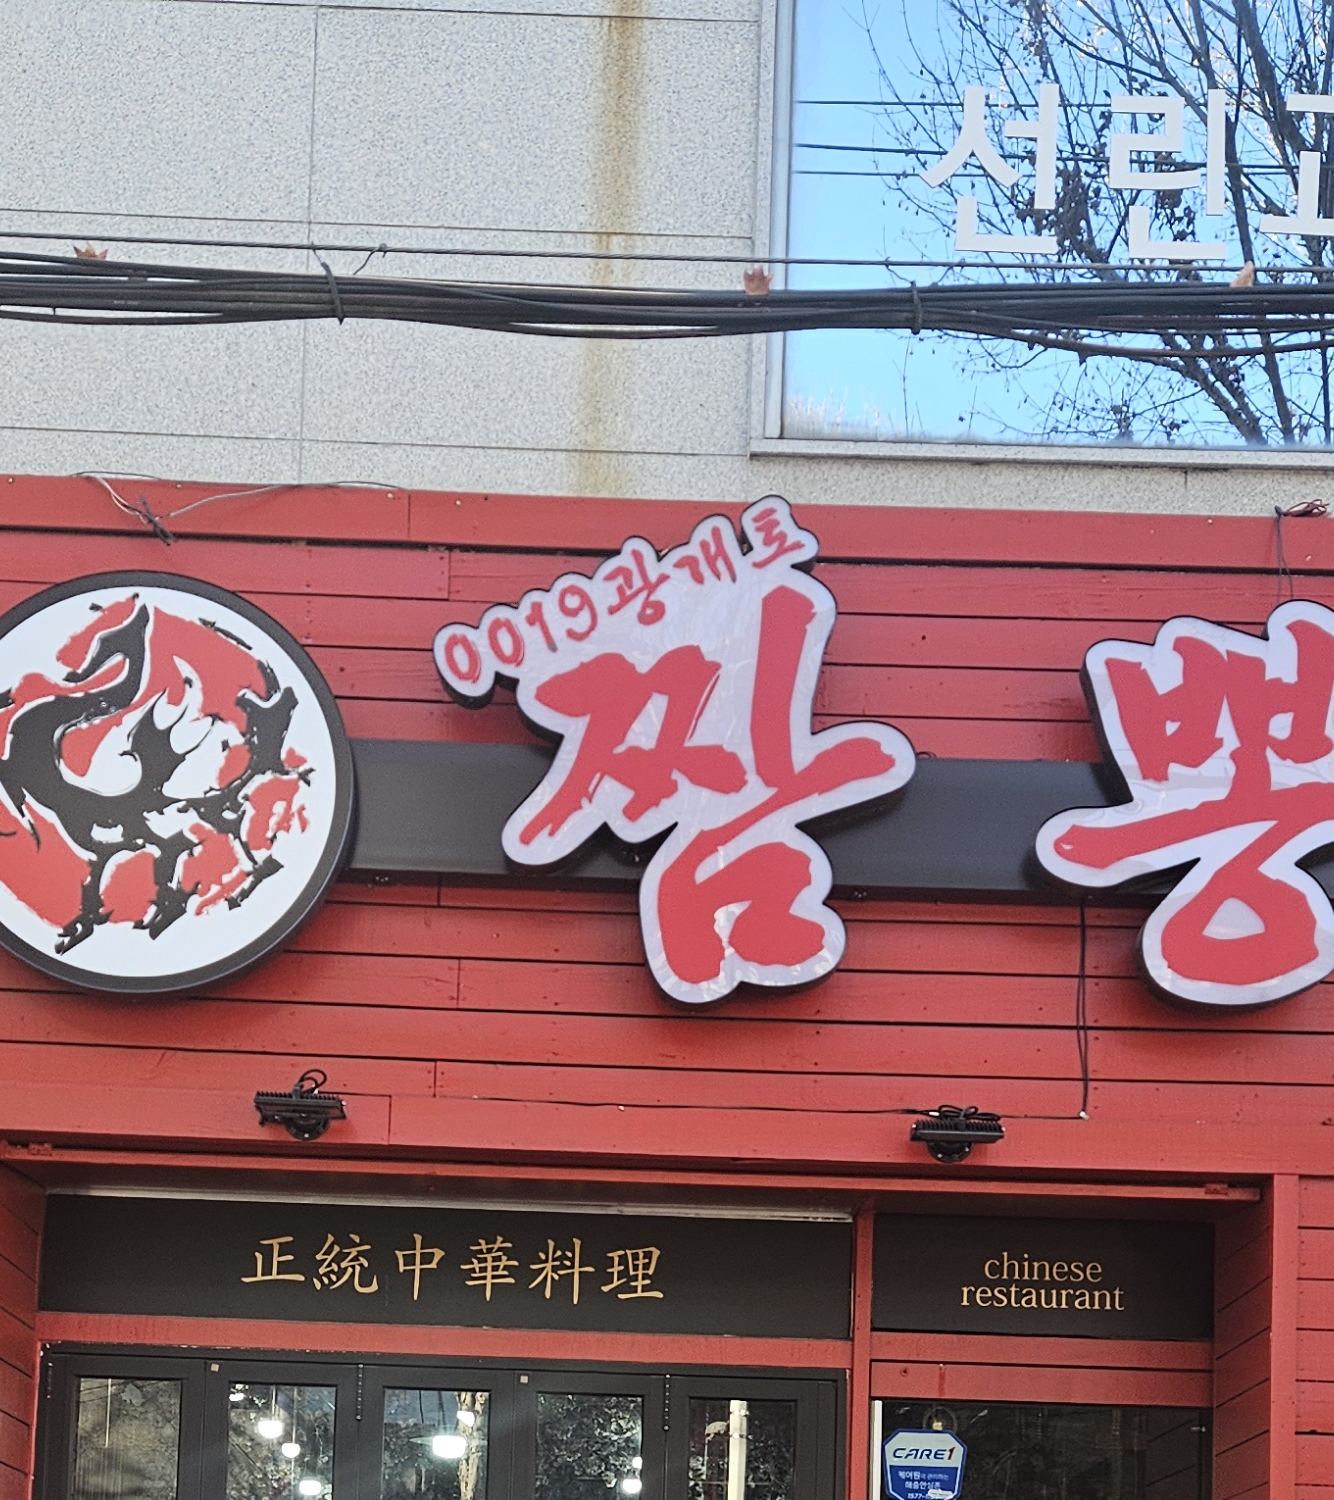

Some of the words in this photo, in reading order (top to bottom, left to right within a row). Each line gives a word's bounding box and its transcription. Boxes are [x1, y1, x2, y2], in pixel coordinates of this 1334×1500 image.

[444, 506, 808, 684] 0019광개토
[241, 1231, 666, 1304] 正統中華料理
[984, 1251, 1103, 1282] chinese
[960, 1278, 1126, 1311] restaurant
[893, 1446, 956, 1461] CARE1
